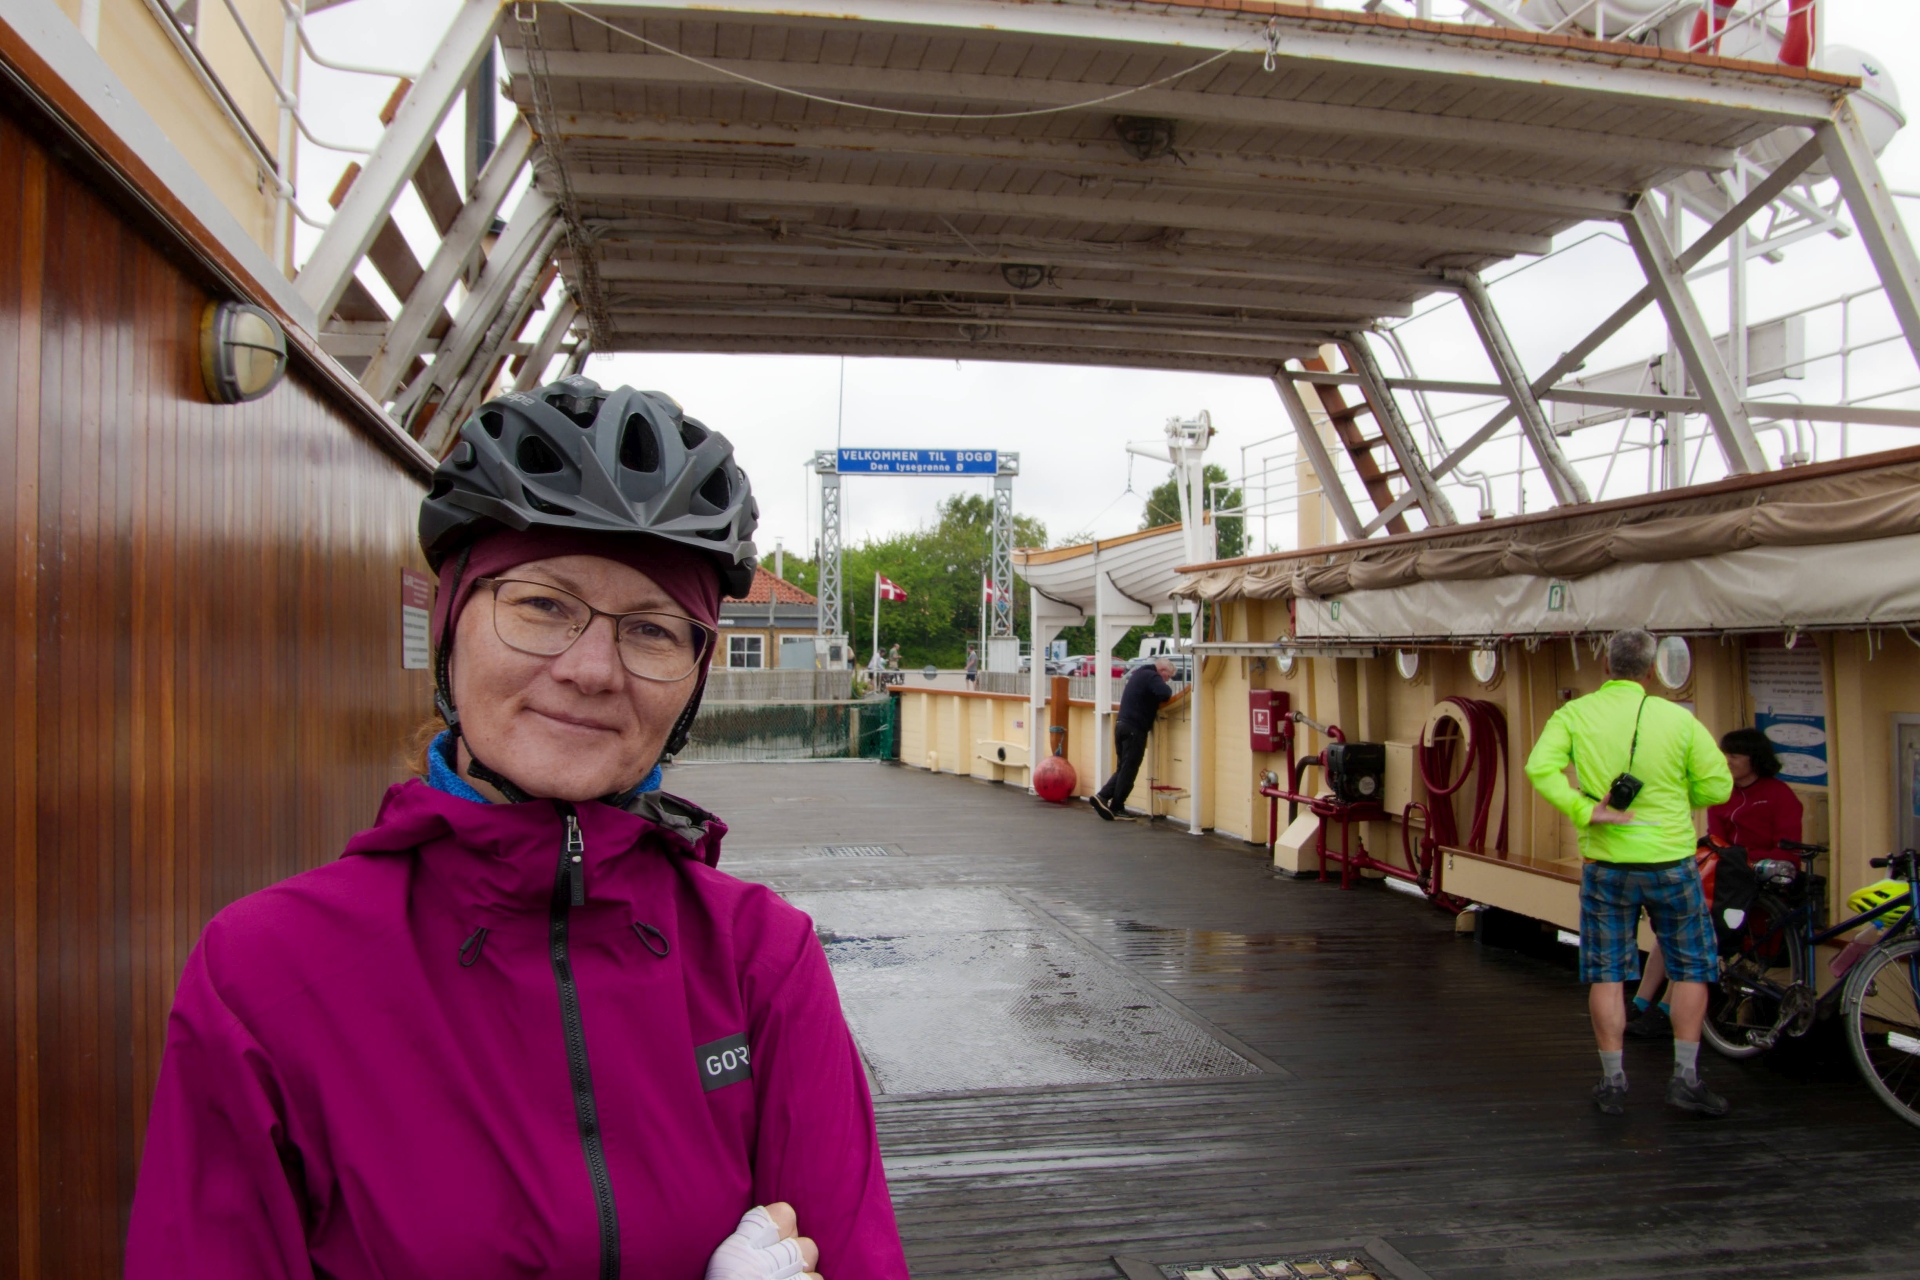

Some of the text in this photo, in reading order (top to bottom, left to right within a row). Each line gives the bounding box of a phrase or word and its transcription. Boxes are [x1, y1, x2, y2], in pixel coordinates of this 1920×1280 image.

[842, 450, 993, 462] VELKOMMEN TIL BOGØ
[870, 462, 964, 472] Den lysegrønne Ø
[706, 1045, 750, 1075] GOR
